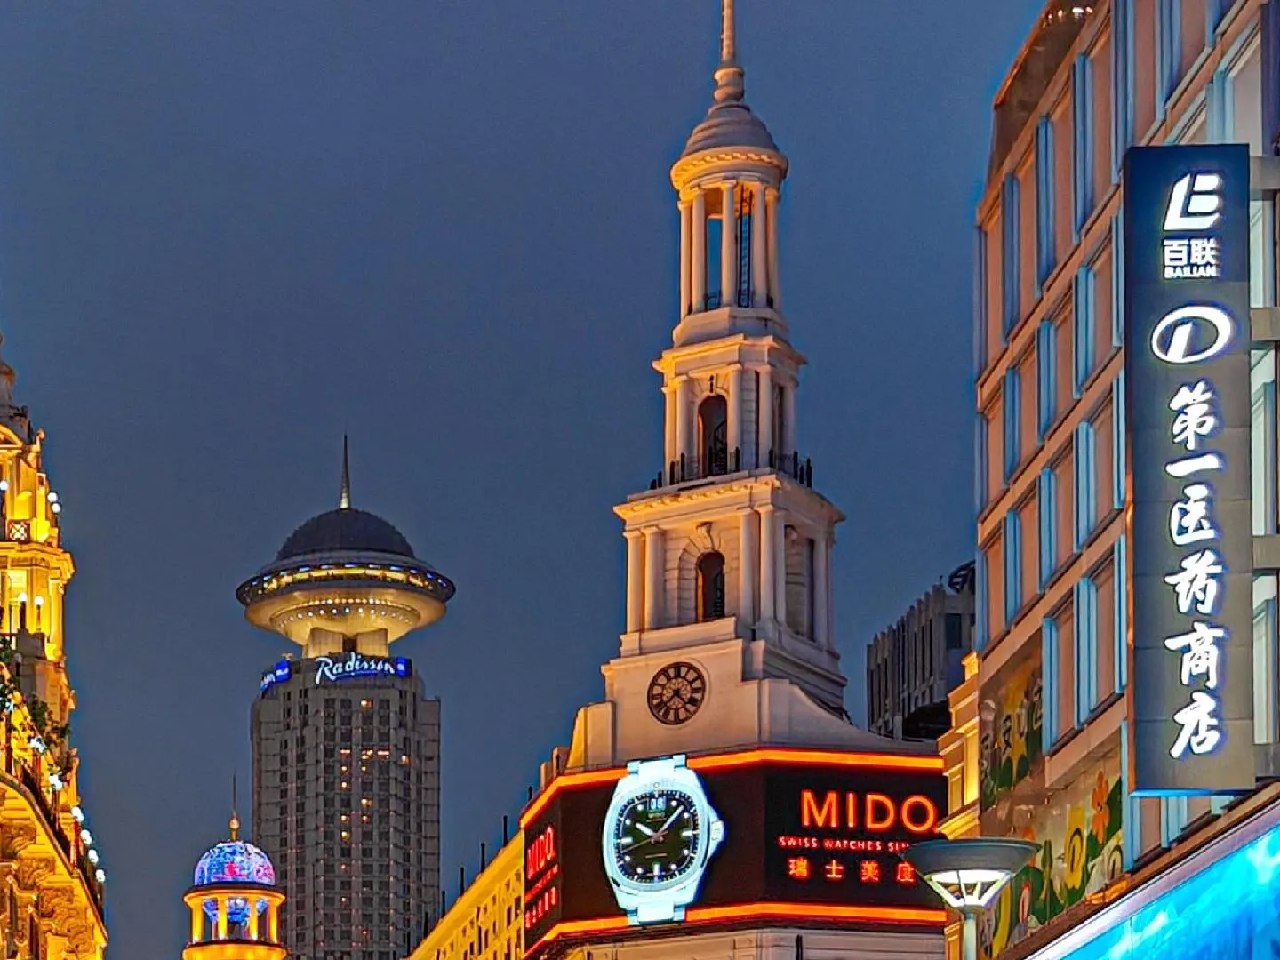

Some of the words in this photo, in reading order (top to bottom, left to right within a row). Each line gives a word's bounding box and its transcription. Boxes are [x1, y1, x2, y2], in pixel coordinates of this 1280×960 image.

[1163, 238, 1219, 266] 百联
[1163, 266, 1219, 279] BAILIAN
[1164, 379, 1223, 759] 第一医药商店
[315, 652, 396, 684] Radisson
[801, 789, 937, 834] MIDO
[778, 836, 818, 848] SWISS
[823, 838, 882, 851] WATCHES
